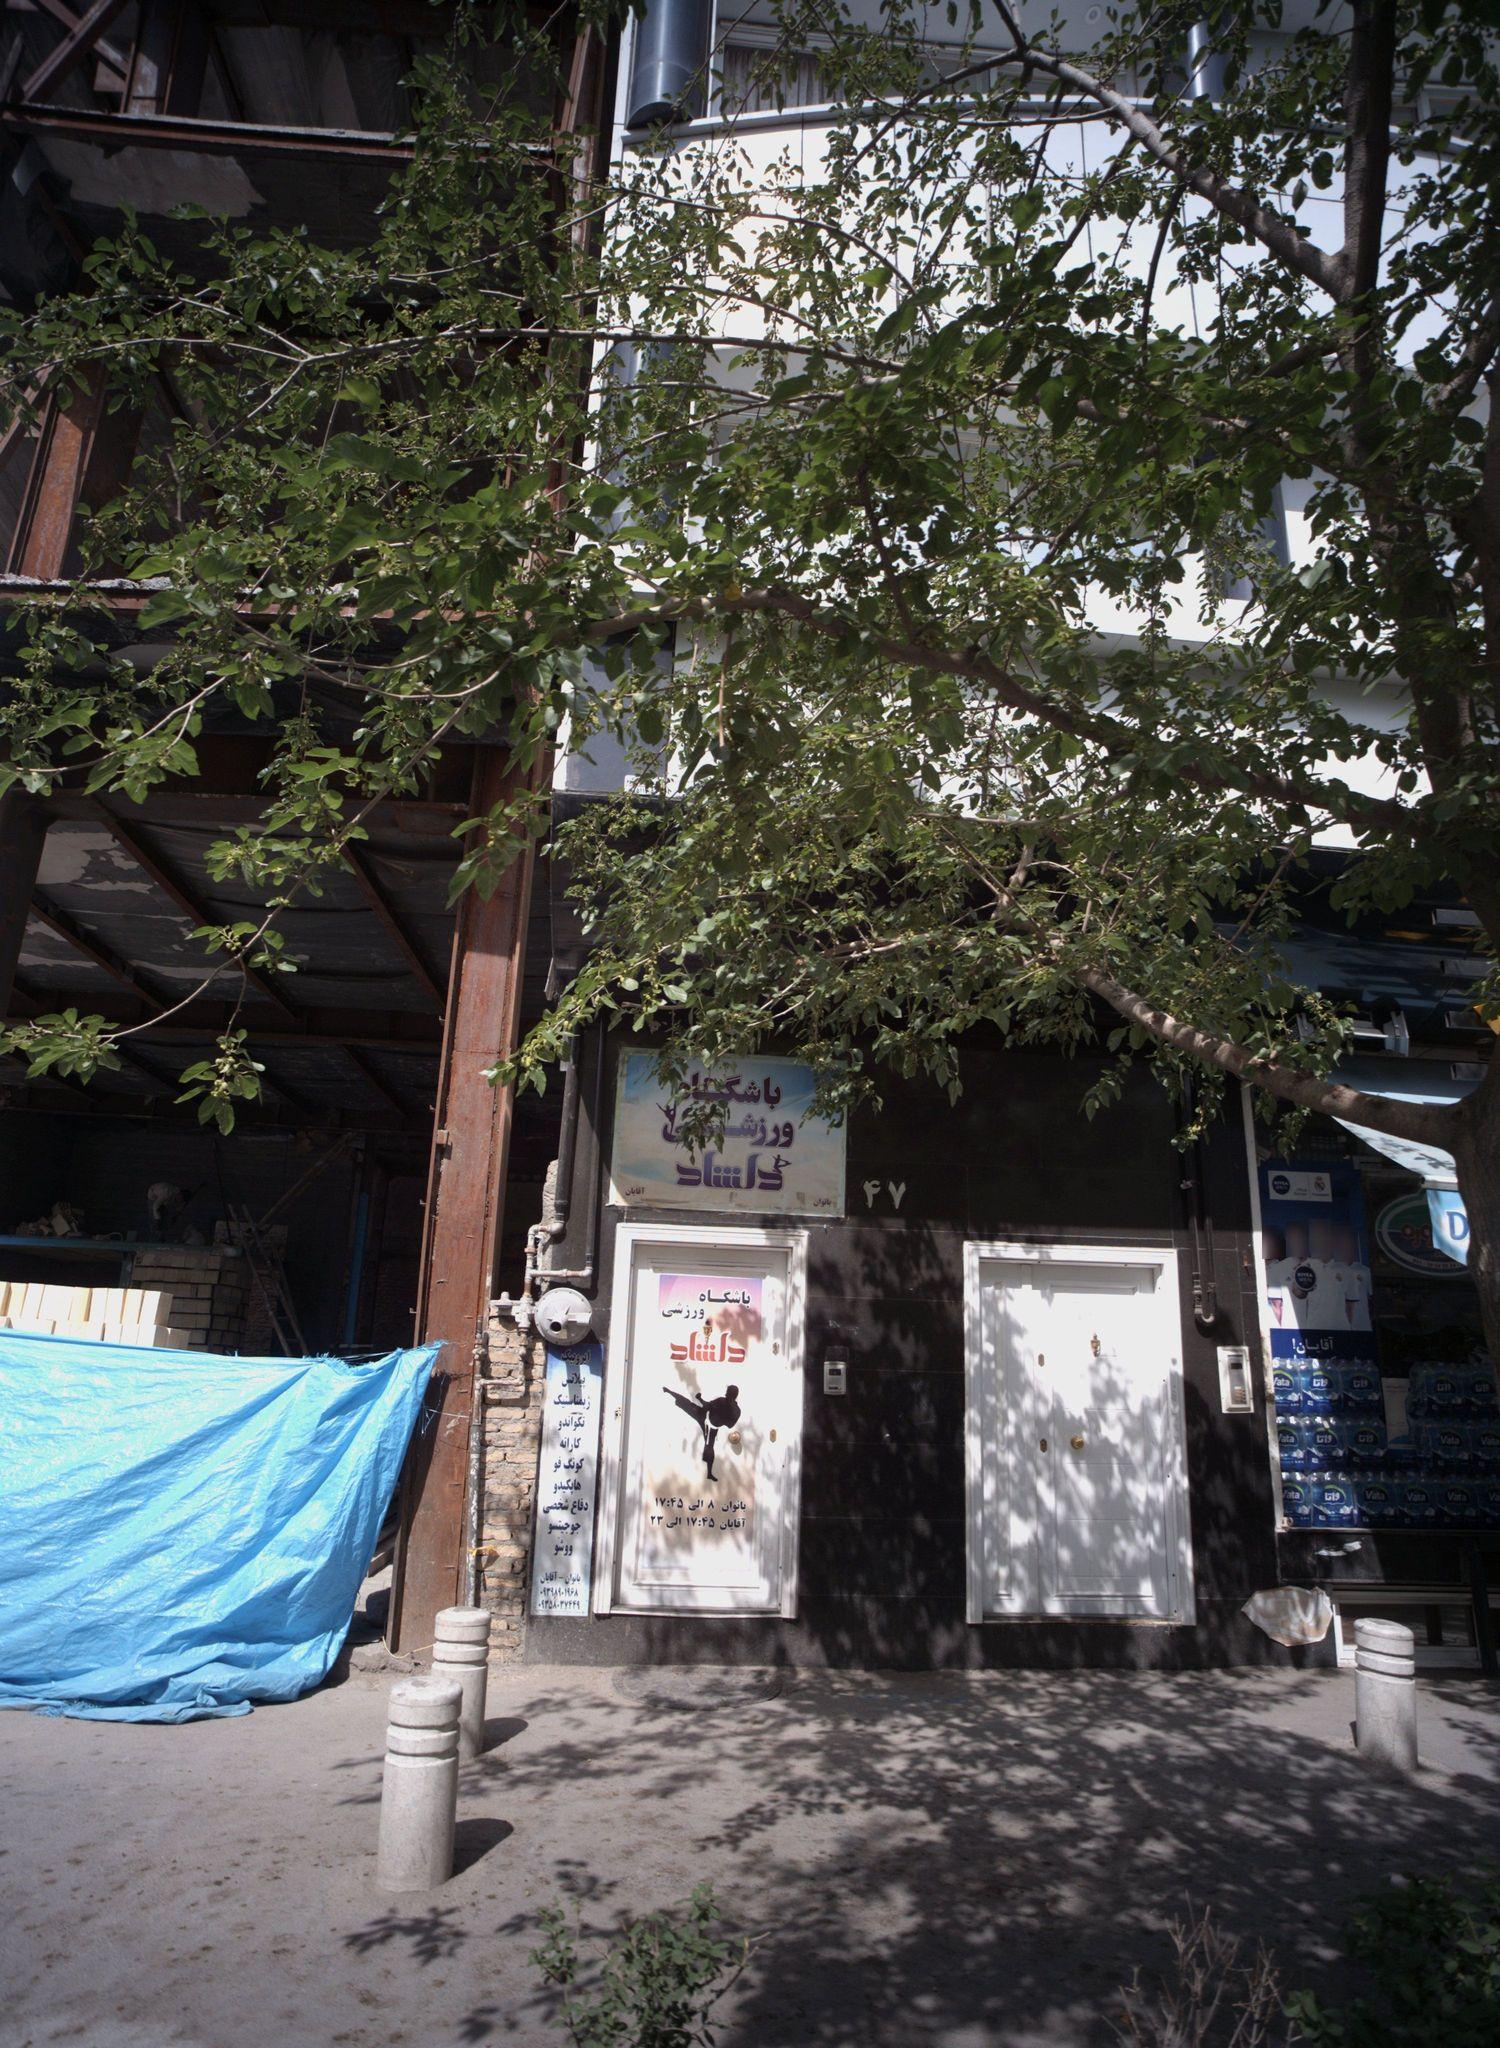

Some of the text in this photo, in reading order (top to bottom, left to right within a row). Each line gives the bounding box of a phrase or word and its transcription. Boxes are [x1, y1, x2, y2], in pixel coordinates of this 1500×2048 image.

[675, 1151, 786, 1191] دلشاد
[624, 1187, 645, 1197] آقایان
[862, 1179, 907, 1210] ۴۷
[812, 1198, 833, 1208] بانوان
[662, 1302, 705, 1320] ورزشی
[670, 1331, 746, 1363] دلشاد
[553, 1456, 562, 1472] فو
[543, 1498, 589, 1515] دفاع شخصی
[688, 1499, 704, 1511] الی
[721, 1501, 747, 1513] بانوان
[666, 1517, 682, 1528] الی
[720, 1517, 747, 1530] آقایان
